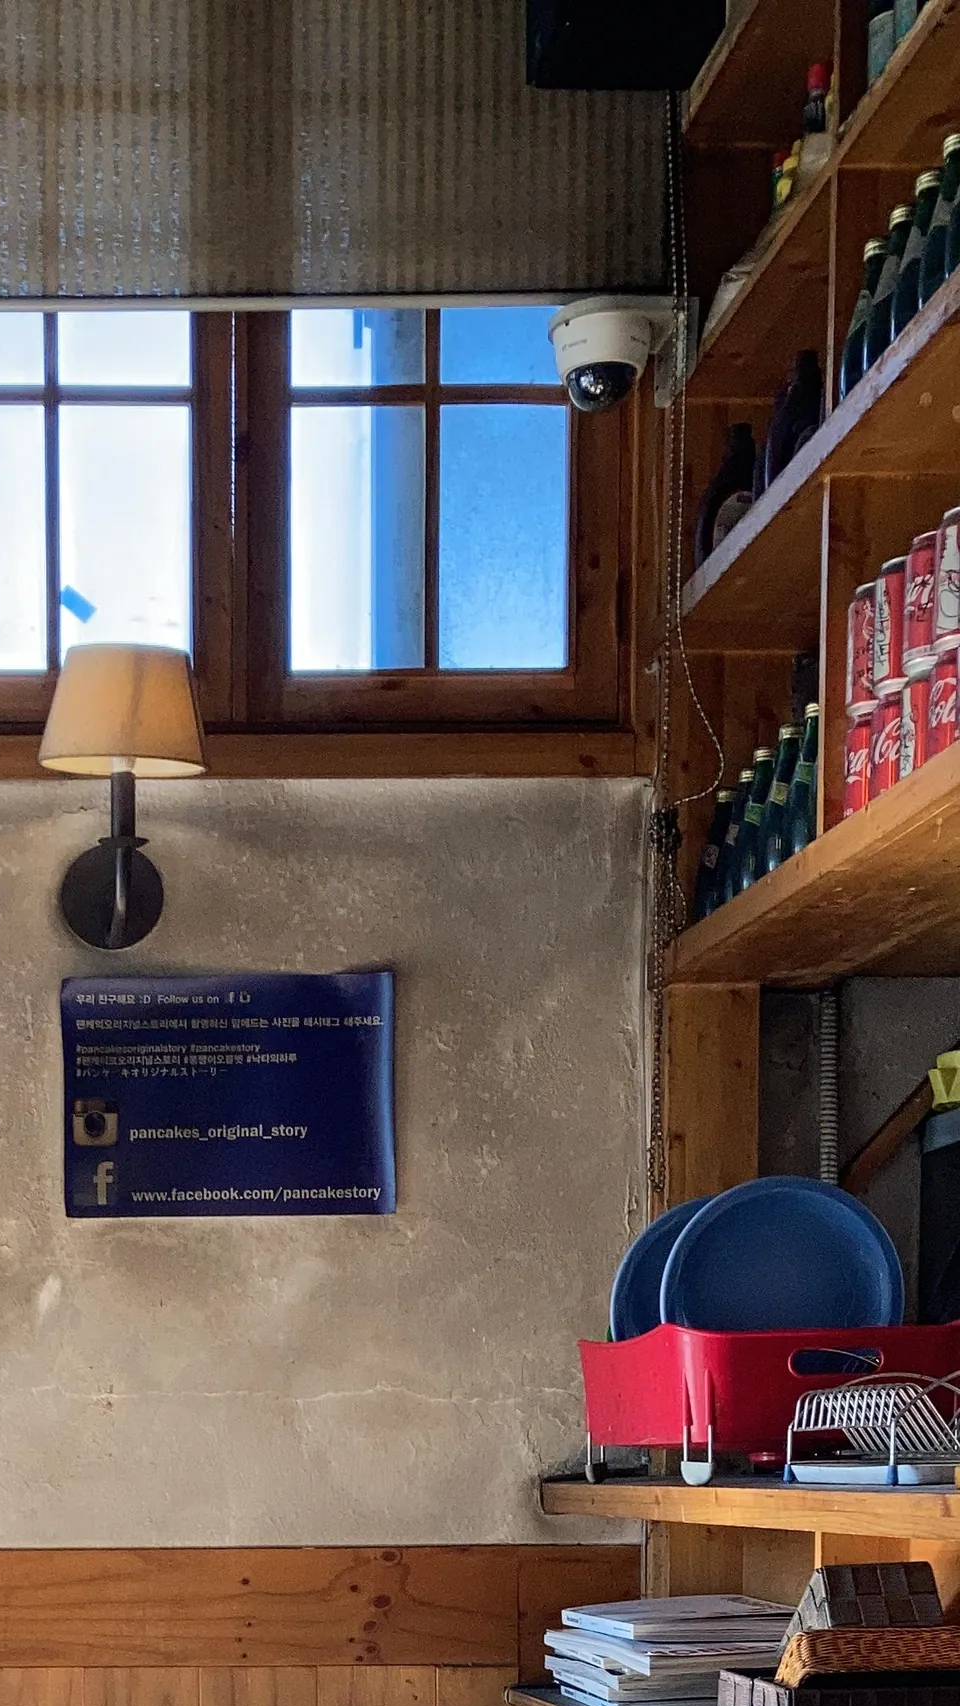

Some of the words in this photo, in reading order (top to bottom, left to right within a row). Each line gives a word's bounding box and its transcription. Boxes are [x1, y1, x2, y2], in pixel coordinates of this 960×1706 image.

[157, 994, 189, 1004] Follow
[192, 996, 204, 1004] us
[206, 996, 220, 1004] on
[129, 1123, 308, 1141] pancakes_original_story
[131, 1185, 381, 1202] www.facebook.com/pancakestory
